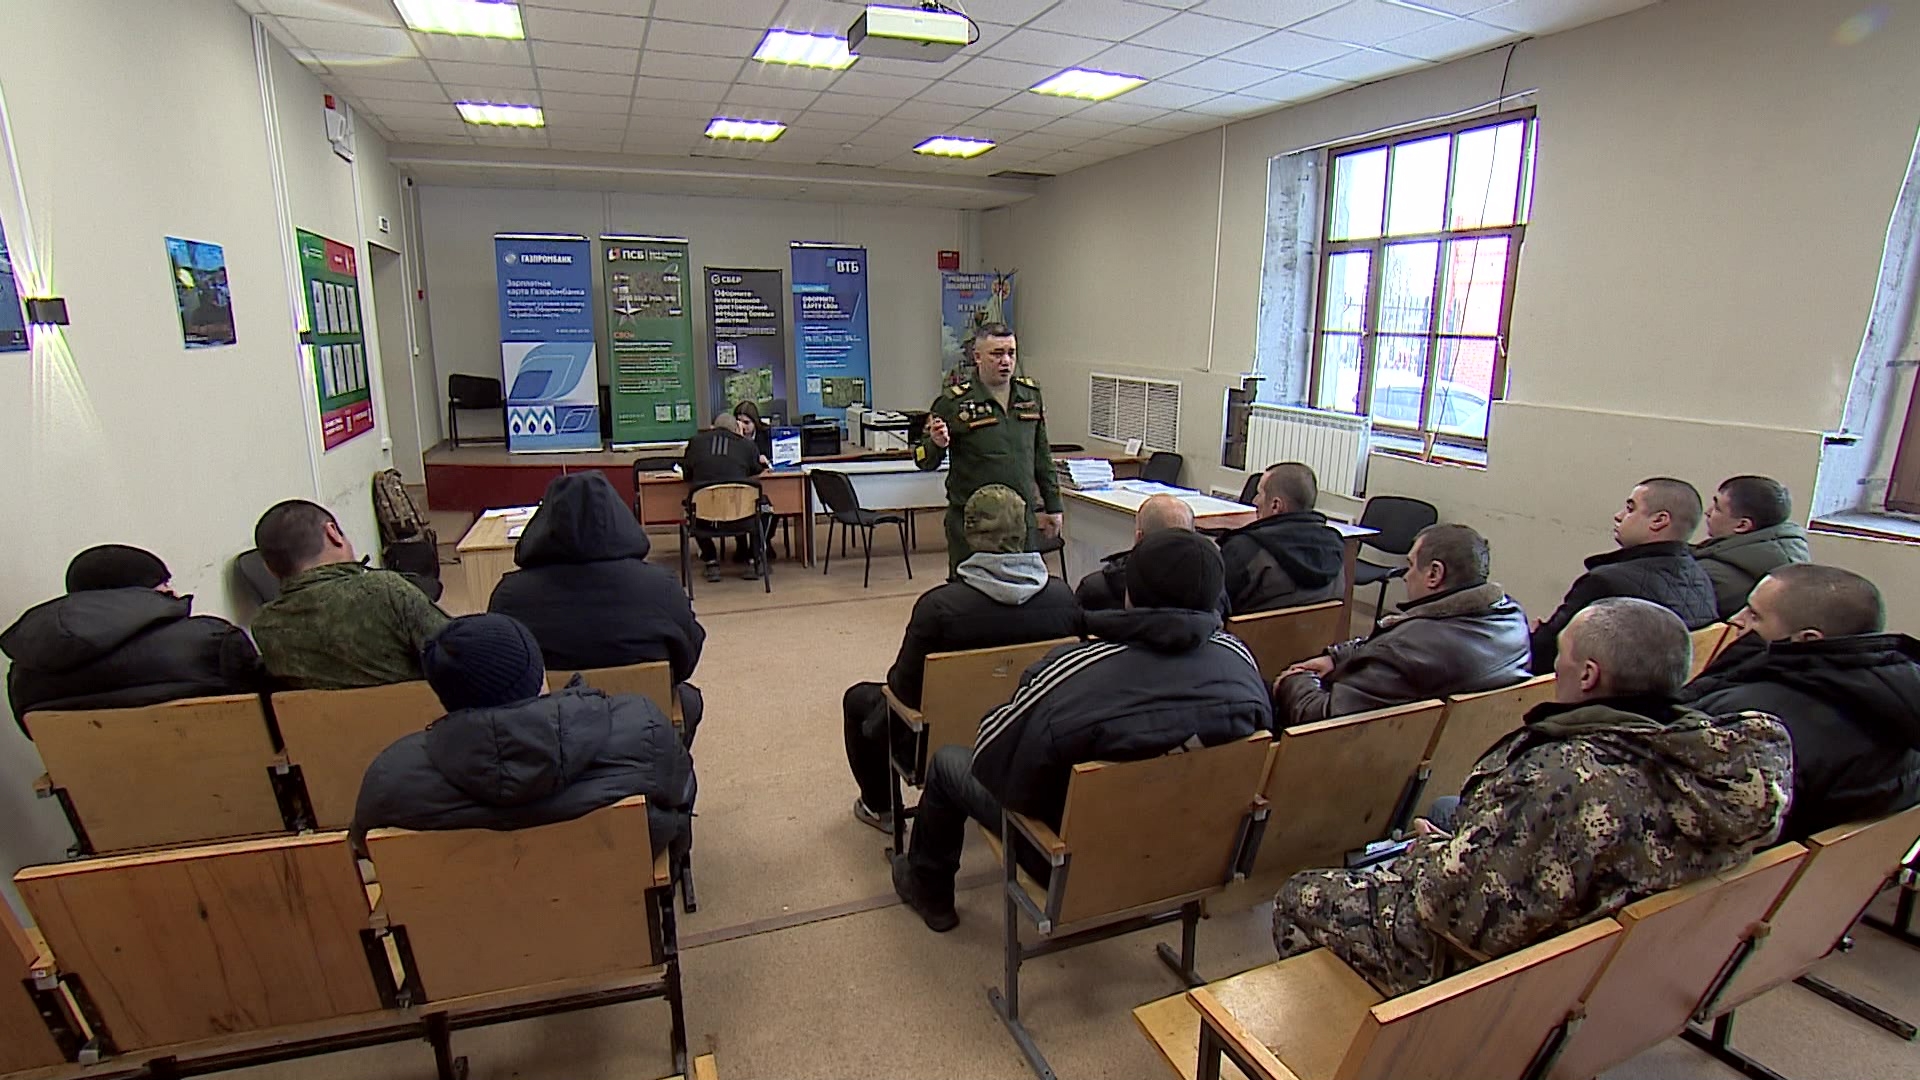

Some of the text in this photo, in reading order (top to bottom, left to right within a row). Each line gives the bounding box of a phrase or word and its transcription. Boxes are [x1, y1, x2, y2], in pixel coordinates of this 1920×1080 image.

[520, 254, 573, 264] ГАЗПРОМБАНК
[622, 249, 645, 260] ПСБ
[836, 260, 860, 273] ВТБ
[506, 279, 552, 289] Зарплатная
[721, 275, 742, 284] СБЕР
[507, 287, 586, 297] карта Газпромбанка
[714, 289, 752, 298] Оформите
[714, 297, 761, 305] электронное
[714, 304, 769, 312] удостоверение
[715, 310, 776, 319] ветерана боевых
[715, 317, 749, 325] действий
